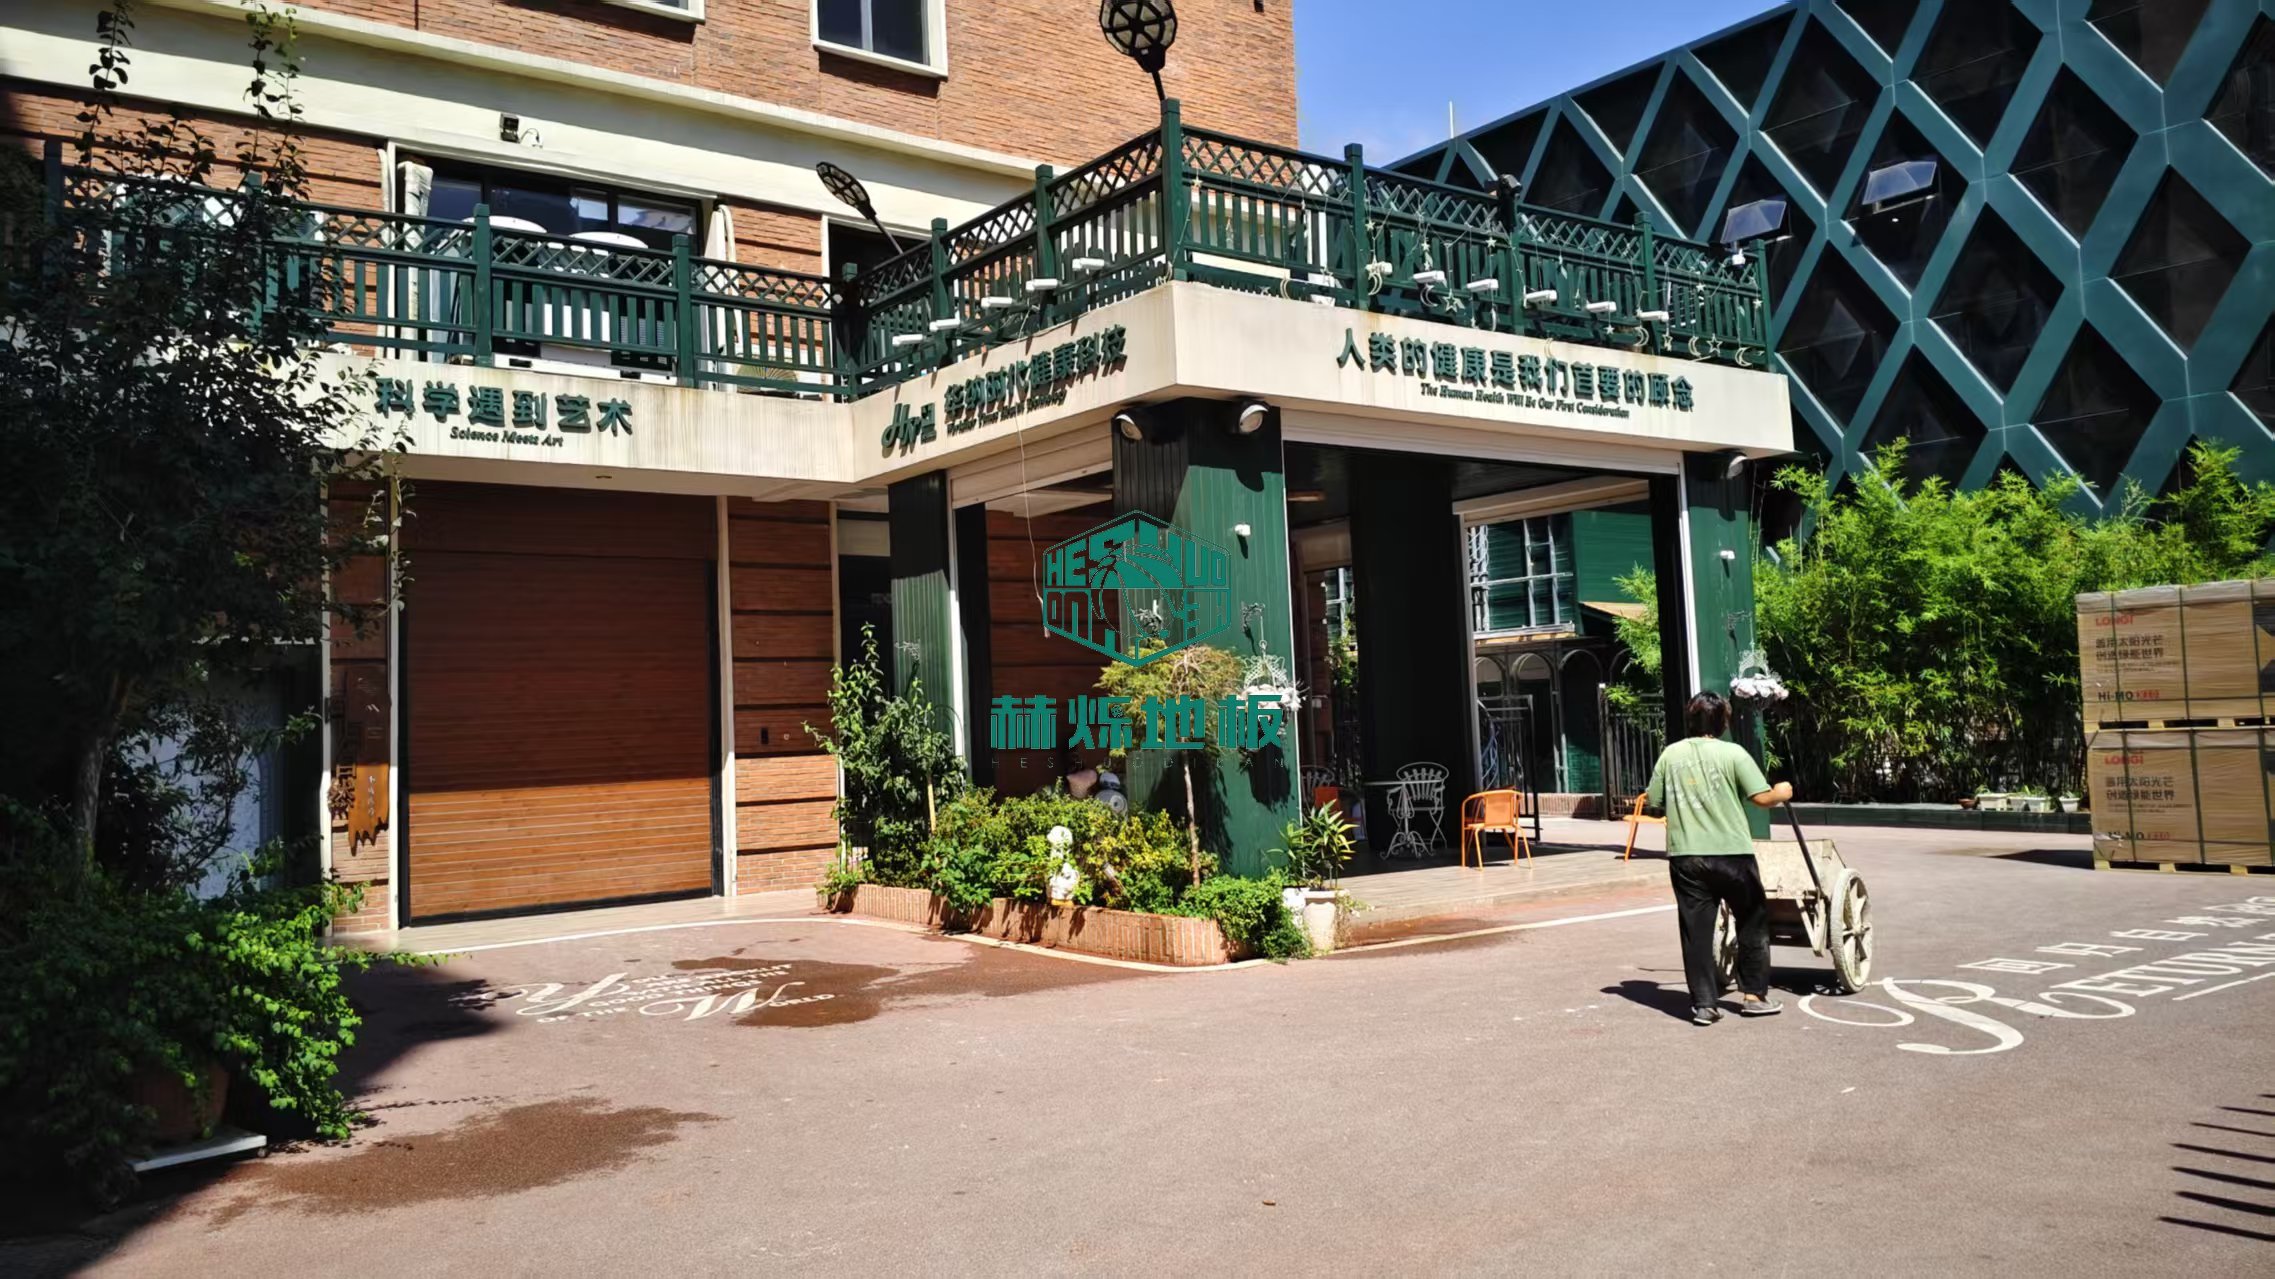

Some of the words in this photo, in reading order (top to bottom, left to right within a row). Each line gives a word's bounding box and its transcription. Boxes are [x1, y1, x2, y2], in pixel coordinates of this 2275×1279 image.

[944, 323, 1127, 416] 华纳时代健康科技
[1337, 327, 1694, 412] 人类的健康是我们首要的顾念
[374, 377, 634, 437] 科学遇到艺术
[1420, 382, 1438, 396] The
[1440, 385, 1473, 400] Human
[1475, 389, 1504, 405] Health
[1506, 393, 1524, 407] Will
[1525, 395, 1536, 408] Be
[1538, 397, 1554, 410] Our
[1556, 399, 1574, 413] First
[1576, 402, 1630, 418] Consideration
[450, 426, 499, 442] Science
[502, 430, 539, 446] Meets
[541, 433, 564, 447] Art
[536, 1015, 569, 1023] OF
[576, 1006, 627, 1018] THE
[638, 981, 836, 1022] WORLD
[587, 992, 665, 1007] GOOD
[669, 979, 763, 995] THINGS
